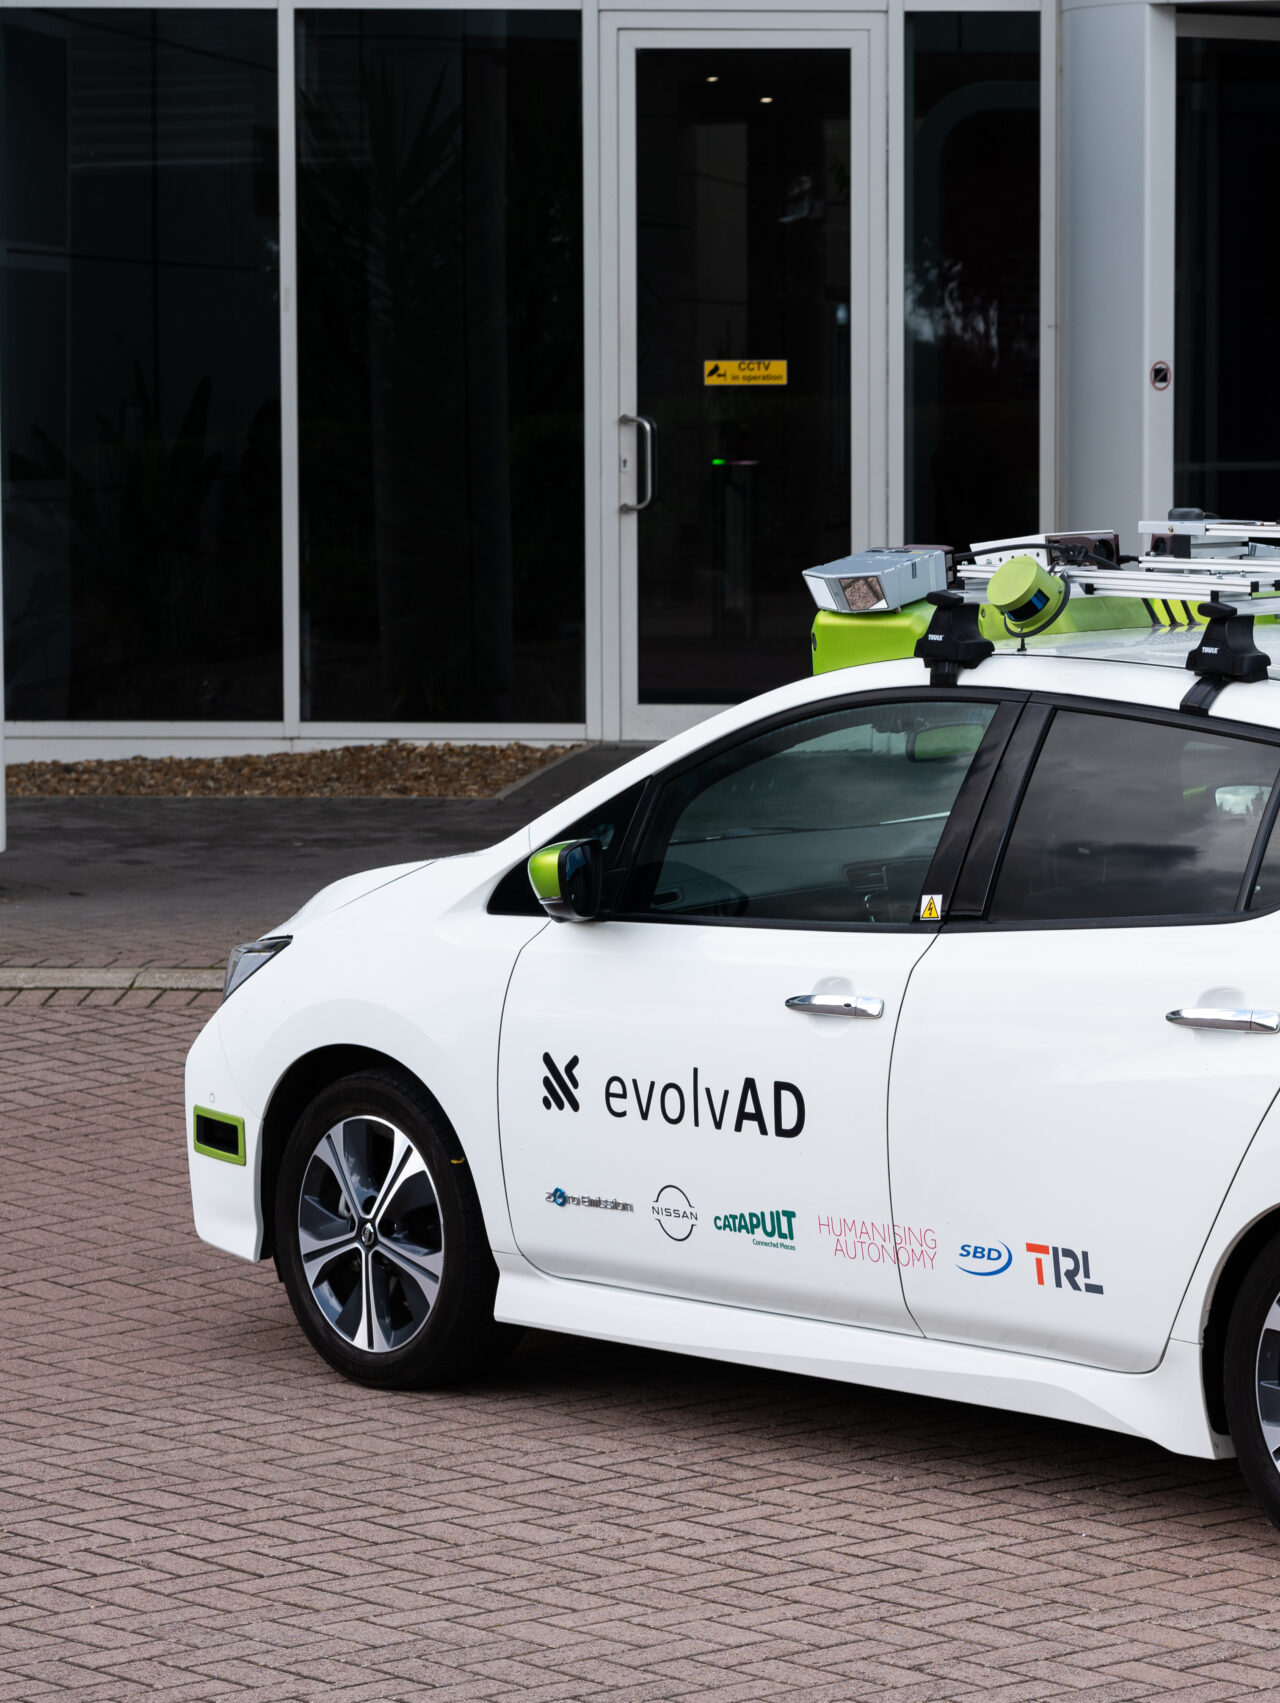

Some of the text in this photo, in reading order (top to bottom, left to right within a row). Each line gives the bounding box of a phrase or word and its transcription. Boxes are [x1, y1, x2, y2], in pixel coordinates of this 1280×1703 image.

[738, 361, 771, 371] CCTV
[742, 374, 783, 383] operation
[605, 1067, 806, 1139] evolvAD
[652, 1206, 698, 1221] NISSAN
[713, 1209, 796, 1241] CATAPULT
[752, 1238, 796, 1251] Connected Places
[817, 1214, 938, 1250] HUMANISING
[834, 1238, 937, 1271] AUTONOMY
[959, 1243, 1002, 1261] SBD
[1025, 1242, 1105, 1295] TRL
